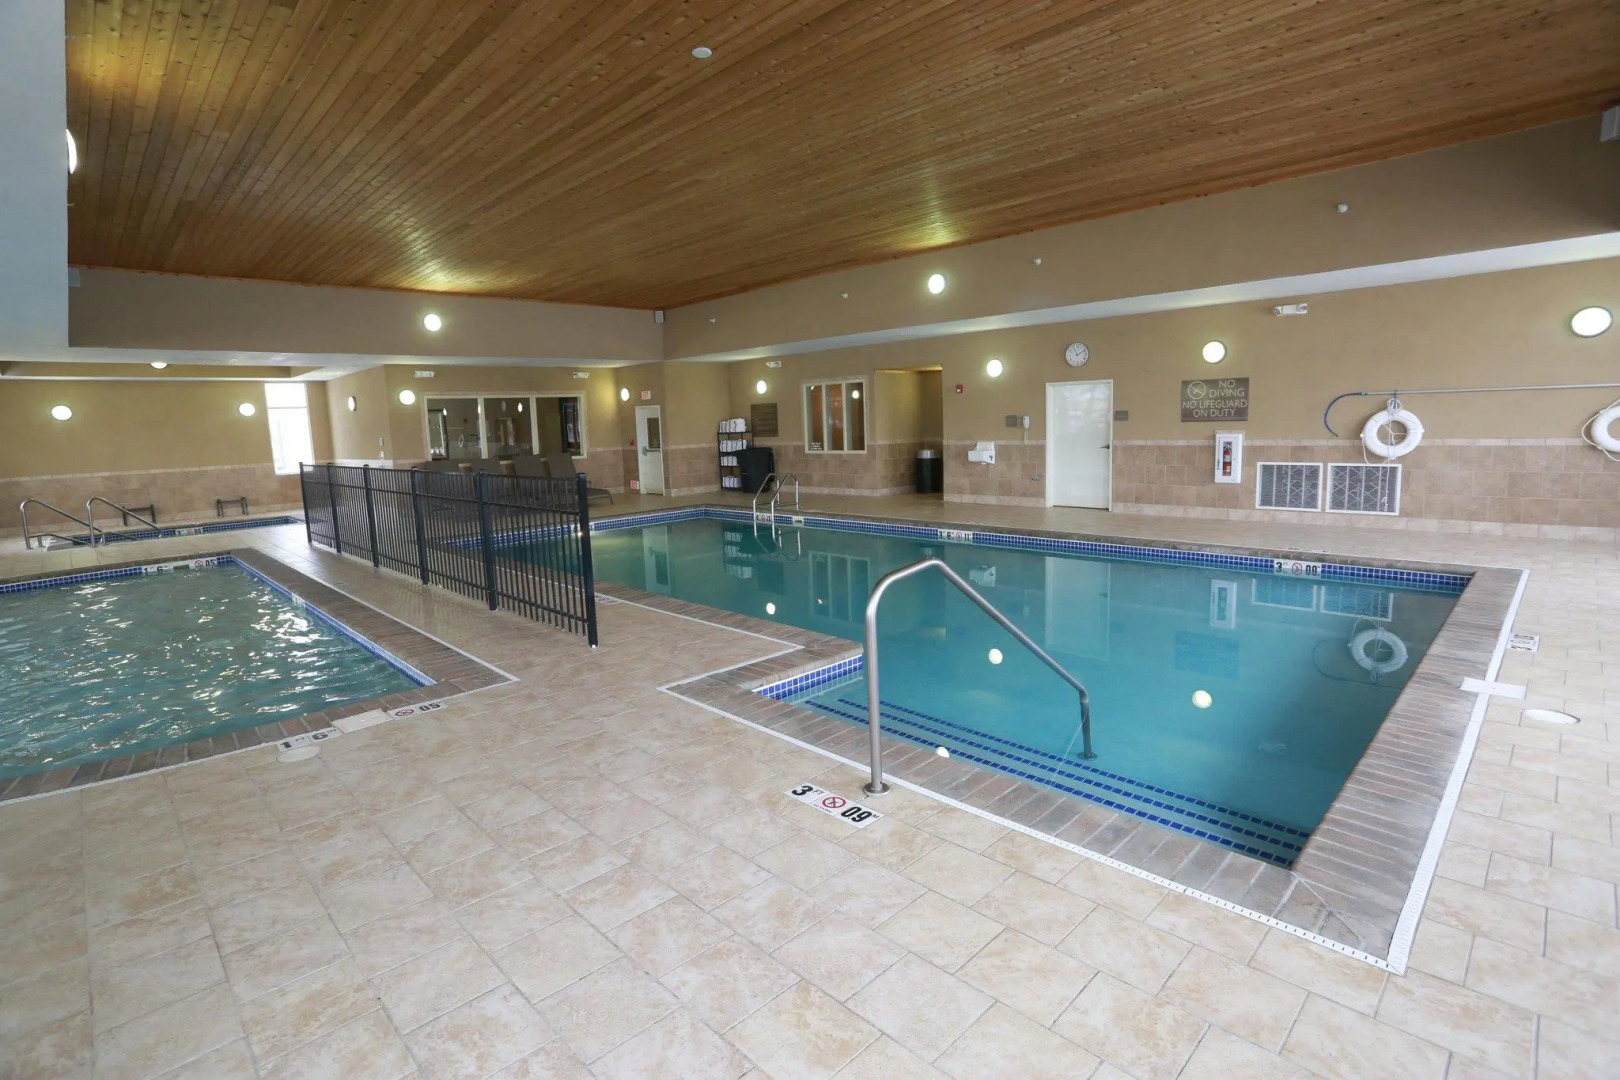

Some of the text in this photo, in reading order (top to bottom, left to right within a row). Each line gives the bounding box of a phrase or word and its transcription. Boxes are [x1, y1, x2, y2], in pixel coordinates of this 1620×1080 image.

[1219, 380, 1236, 388] NO
[1209, 388, 1245, 398] DIVING
[1182, 399, 1248, 409] NO LIFEGUARD
[1193, 408, 1236, 417] ON DUTY
[791, 785, 814, 796] 3
